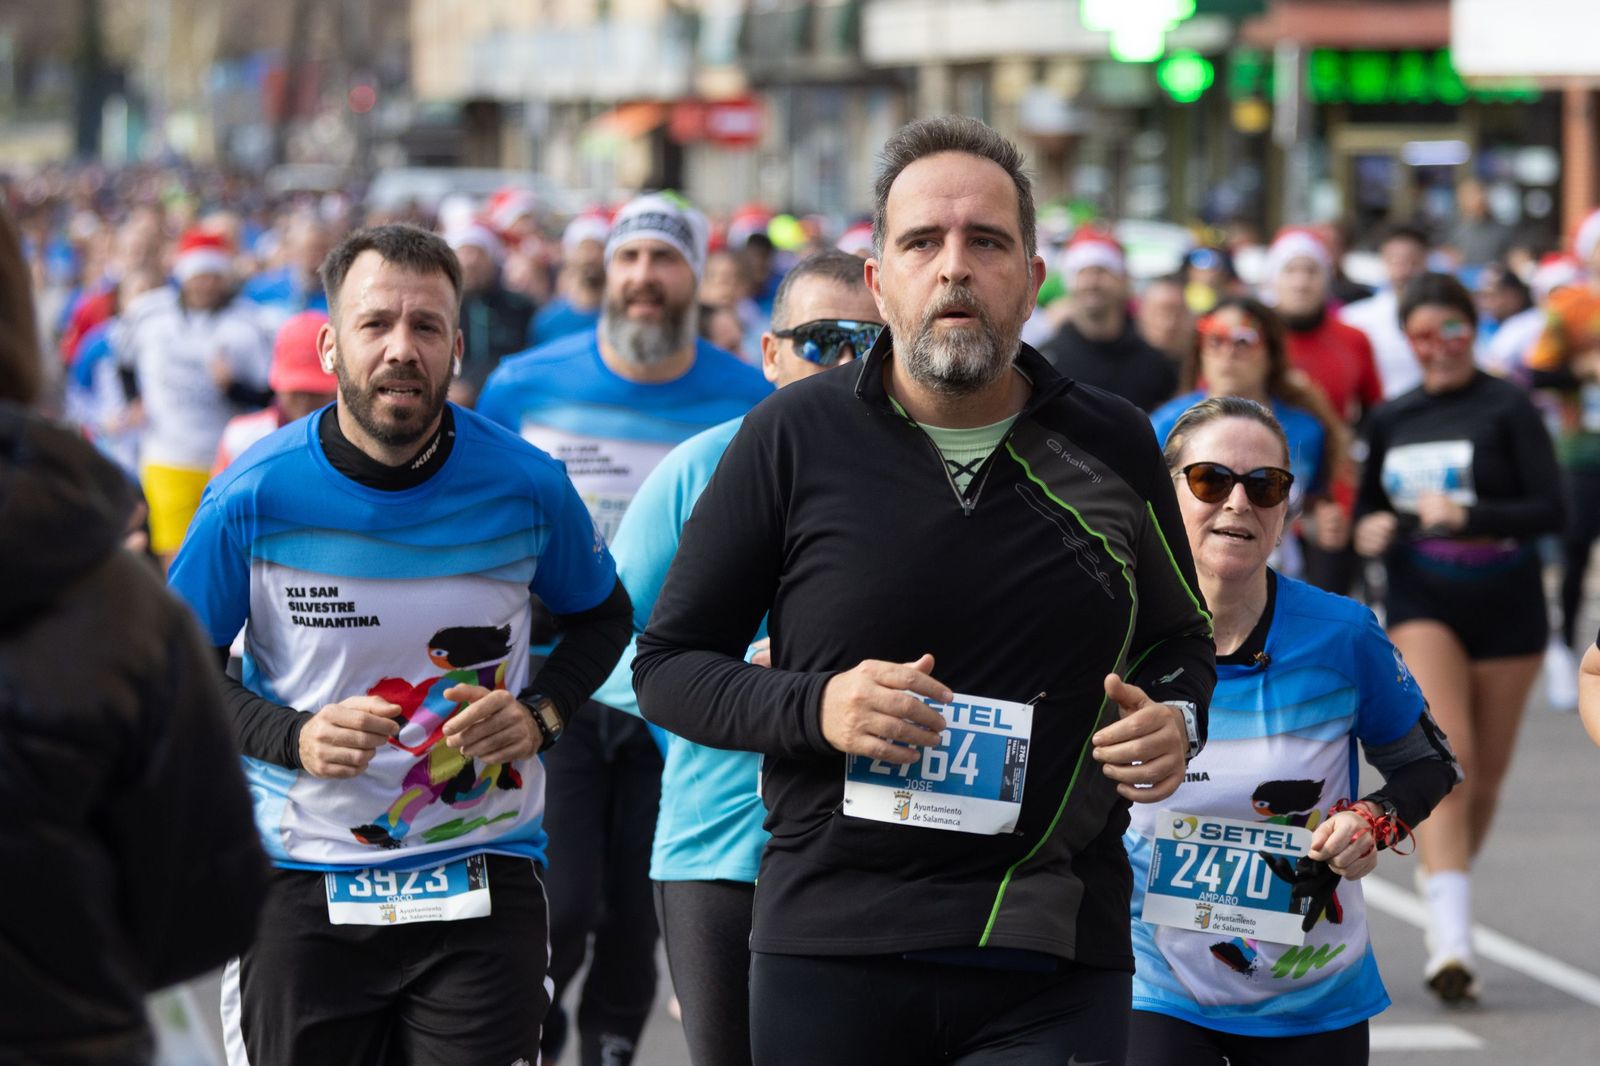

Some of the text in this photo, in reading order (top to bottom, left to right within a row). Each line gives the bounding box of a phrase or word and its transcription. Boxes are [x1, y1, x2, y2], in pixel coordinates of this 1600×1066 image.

[1061, 451, 1103, 484] Kalenji
[285, 586, 339, 598] XLI SAN
[287, 601, 356, 613] SILVESTRE
[291, 615, 381, 629] SALMANTINA
[923, 696, 1013, 731] ETEL
[904, 778, 934, 792] JOSE
[912, 801, 963, 816] Ayuntamiento
[911, 813, 962, 827] de Salamanca
[1200, 821, 1302, 852] SETEL
[1170, 842, 1273, 901] 2470
[1198, 890, 1239, 906] AMPARO
[1212, 912, 1257, 927] Ayuntamiento
[1212, 922, 1256, 936] de Salamanca
